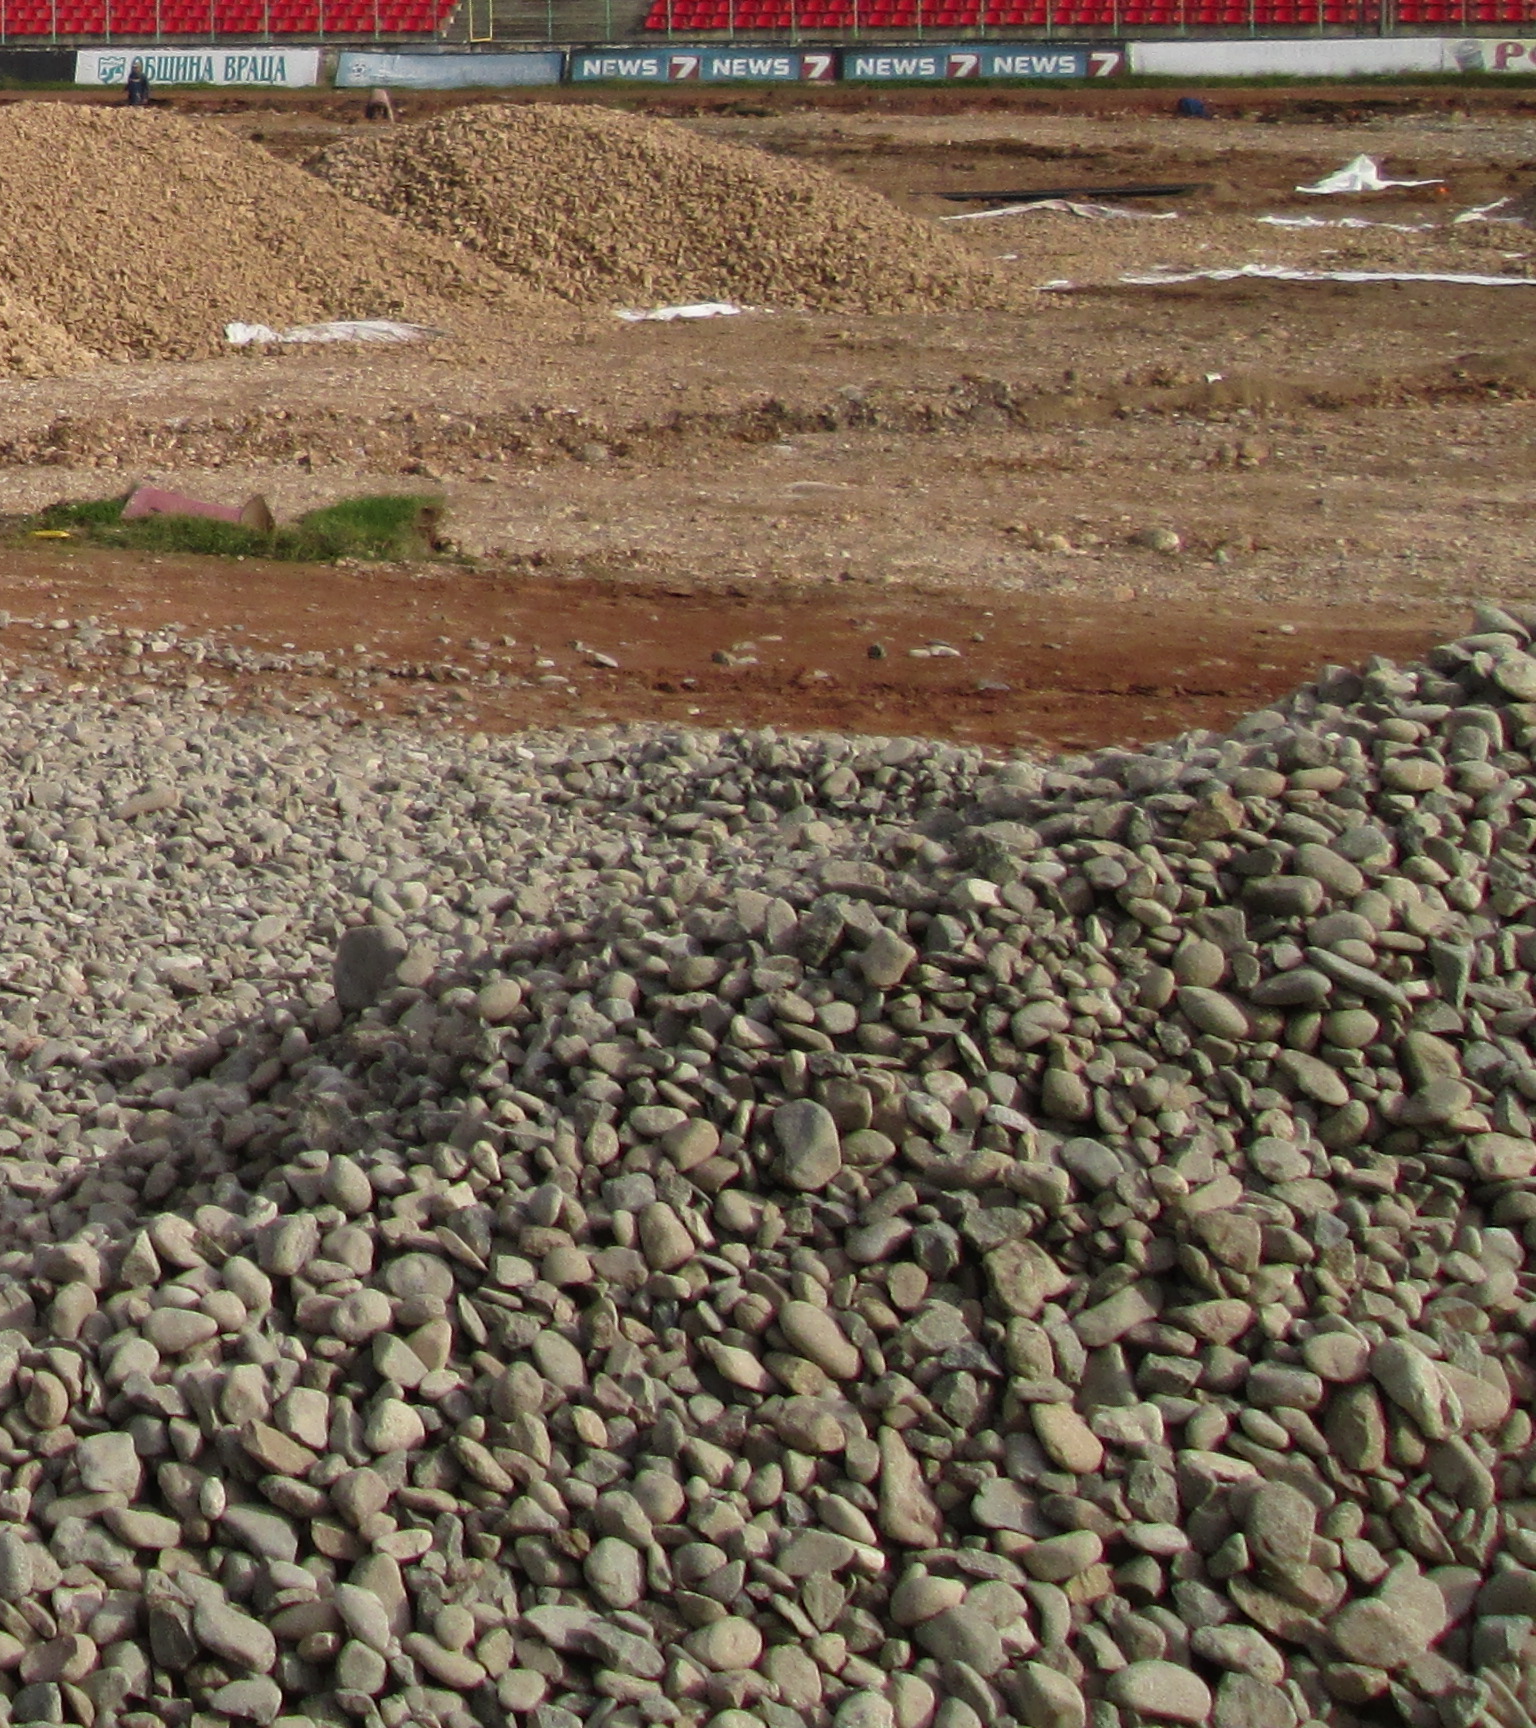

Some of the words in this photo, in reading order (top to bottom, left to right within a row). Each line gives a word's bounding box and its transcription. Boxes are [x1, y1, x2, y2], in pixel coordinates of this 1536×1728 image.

[223, 56, 287, 84] ВРАЦА
[583, 59, 658, 76] NEWS
[671, 57, 698, 79] 7
[712, 58, 790, 76] NEWS
[803, 56, 830, 79] 7
[855, 58, 935, 75] NEWS
[948, 54, 978, 77] 7
[993, 56, 1076, 74] NEWS
[1090, 53, 1120, 77] 7
